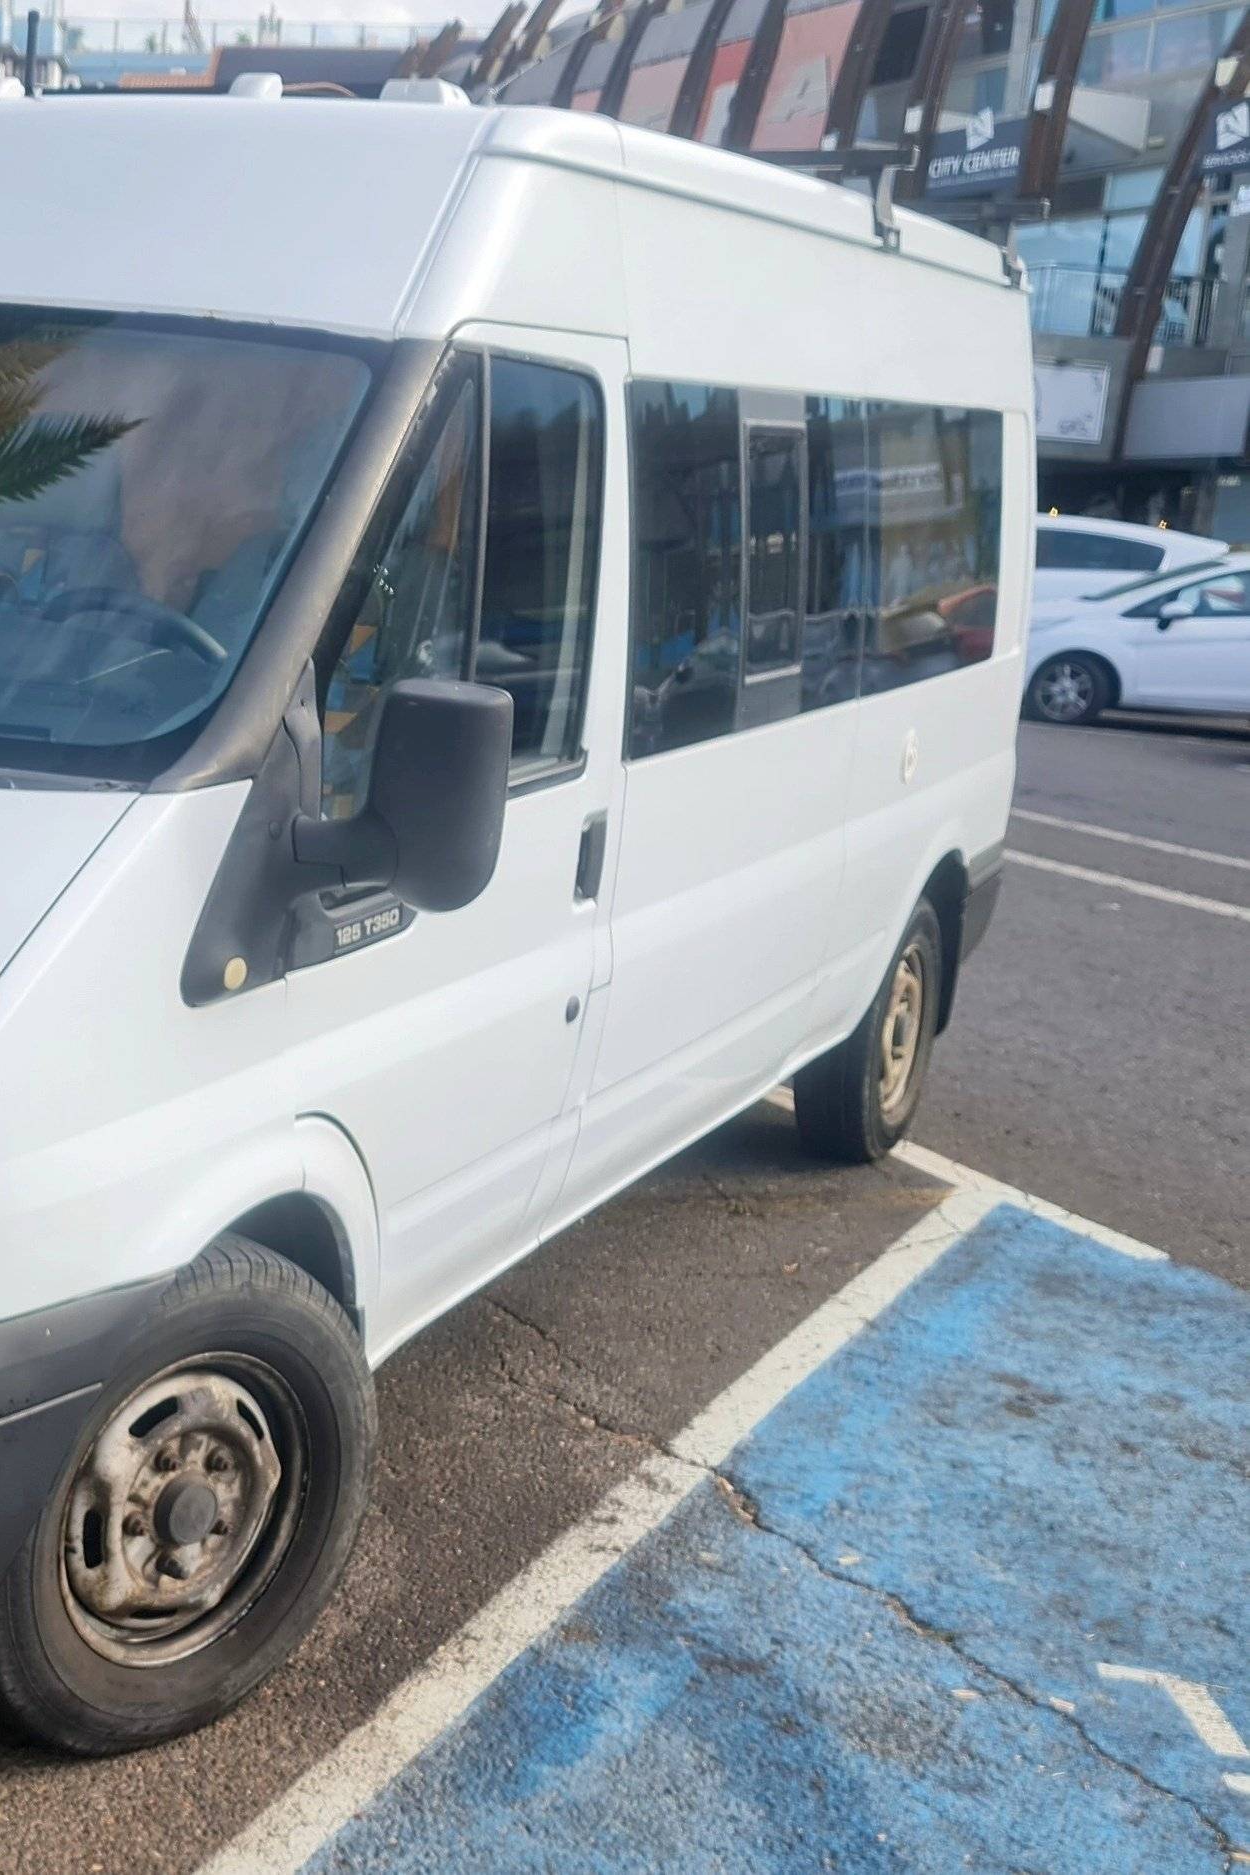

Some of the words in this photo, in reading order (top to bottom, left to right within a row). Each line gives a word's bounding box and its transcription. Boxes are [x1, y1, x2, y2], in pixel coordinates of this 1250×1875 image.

[929, 154, 962, 178] CITY
[962, 146, 1020, 174] CENTER
[336, 922, 362, 947] 125
[364, 907, 400, 936] T350
